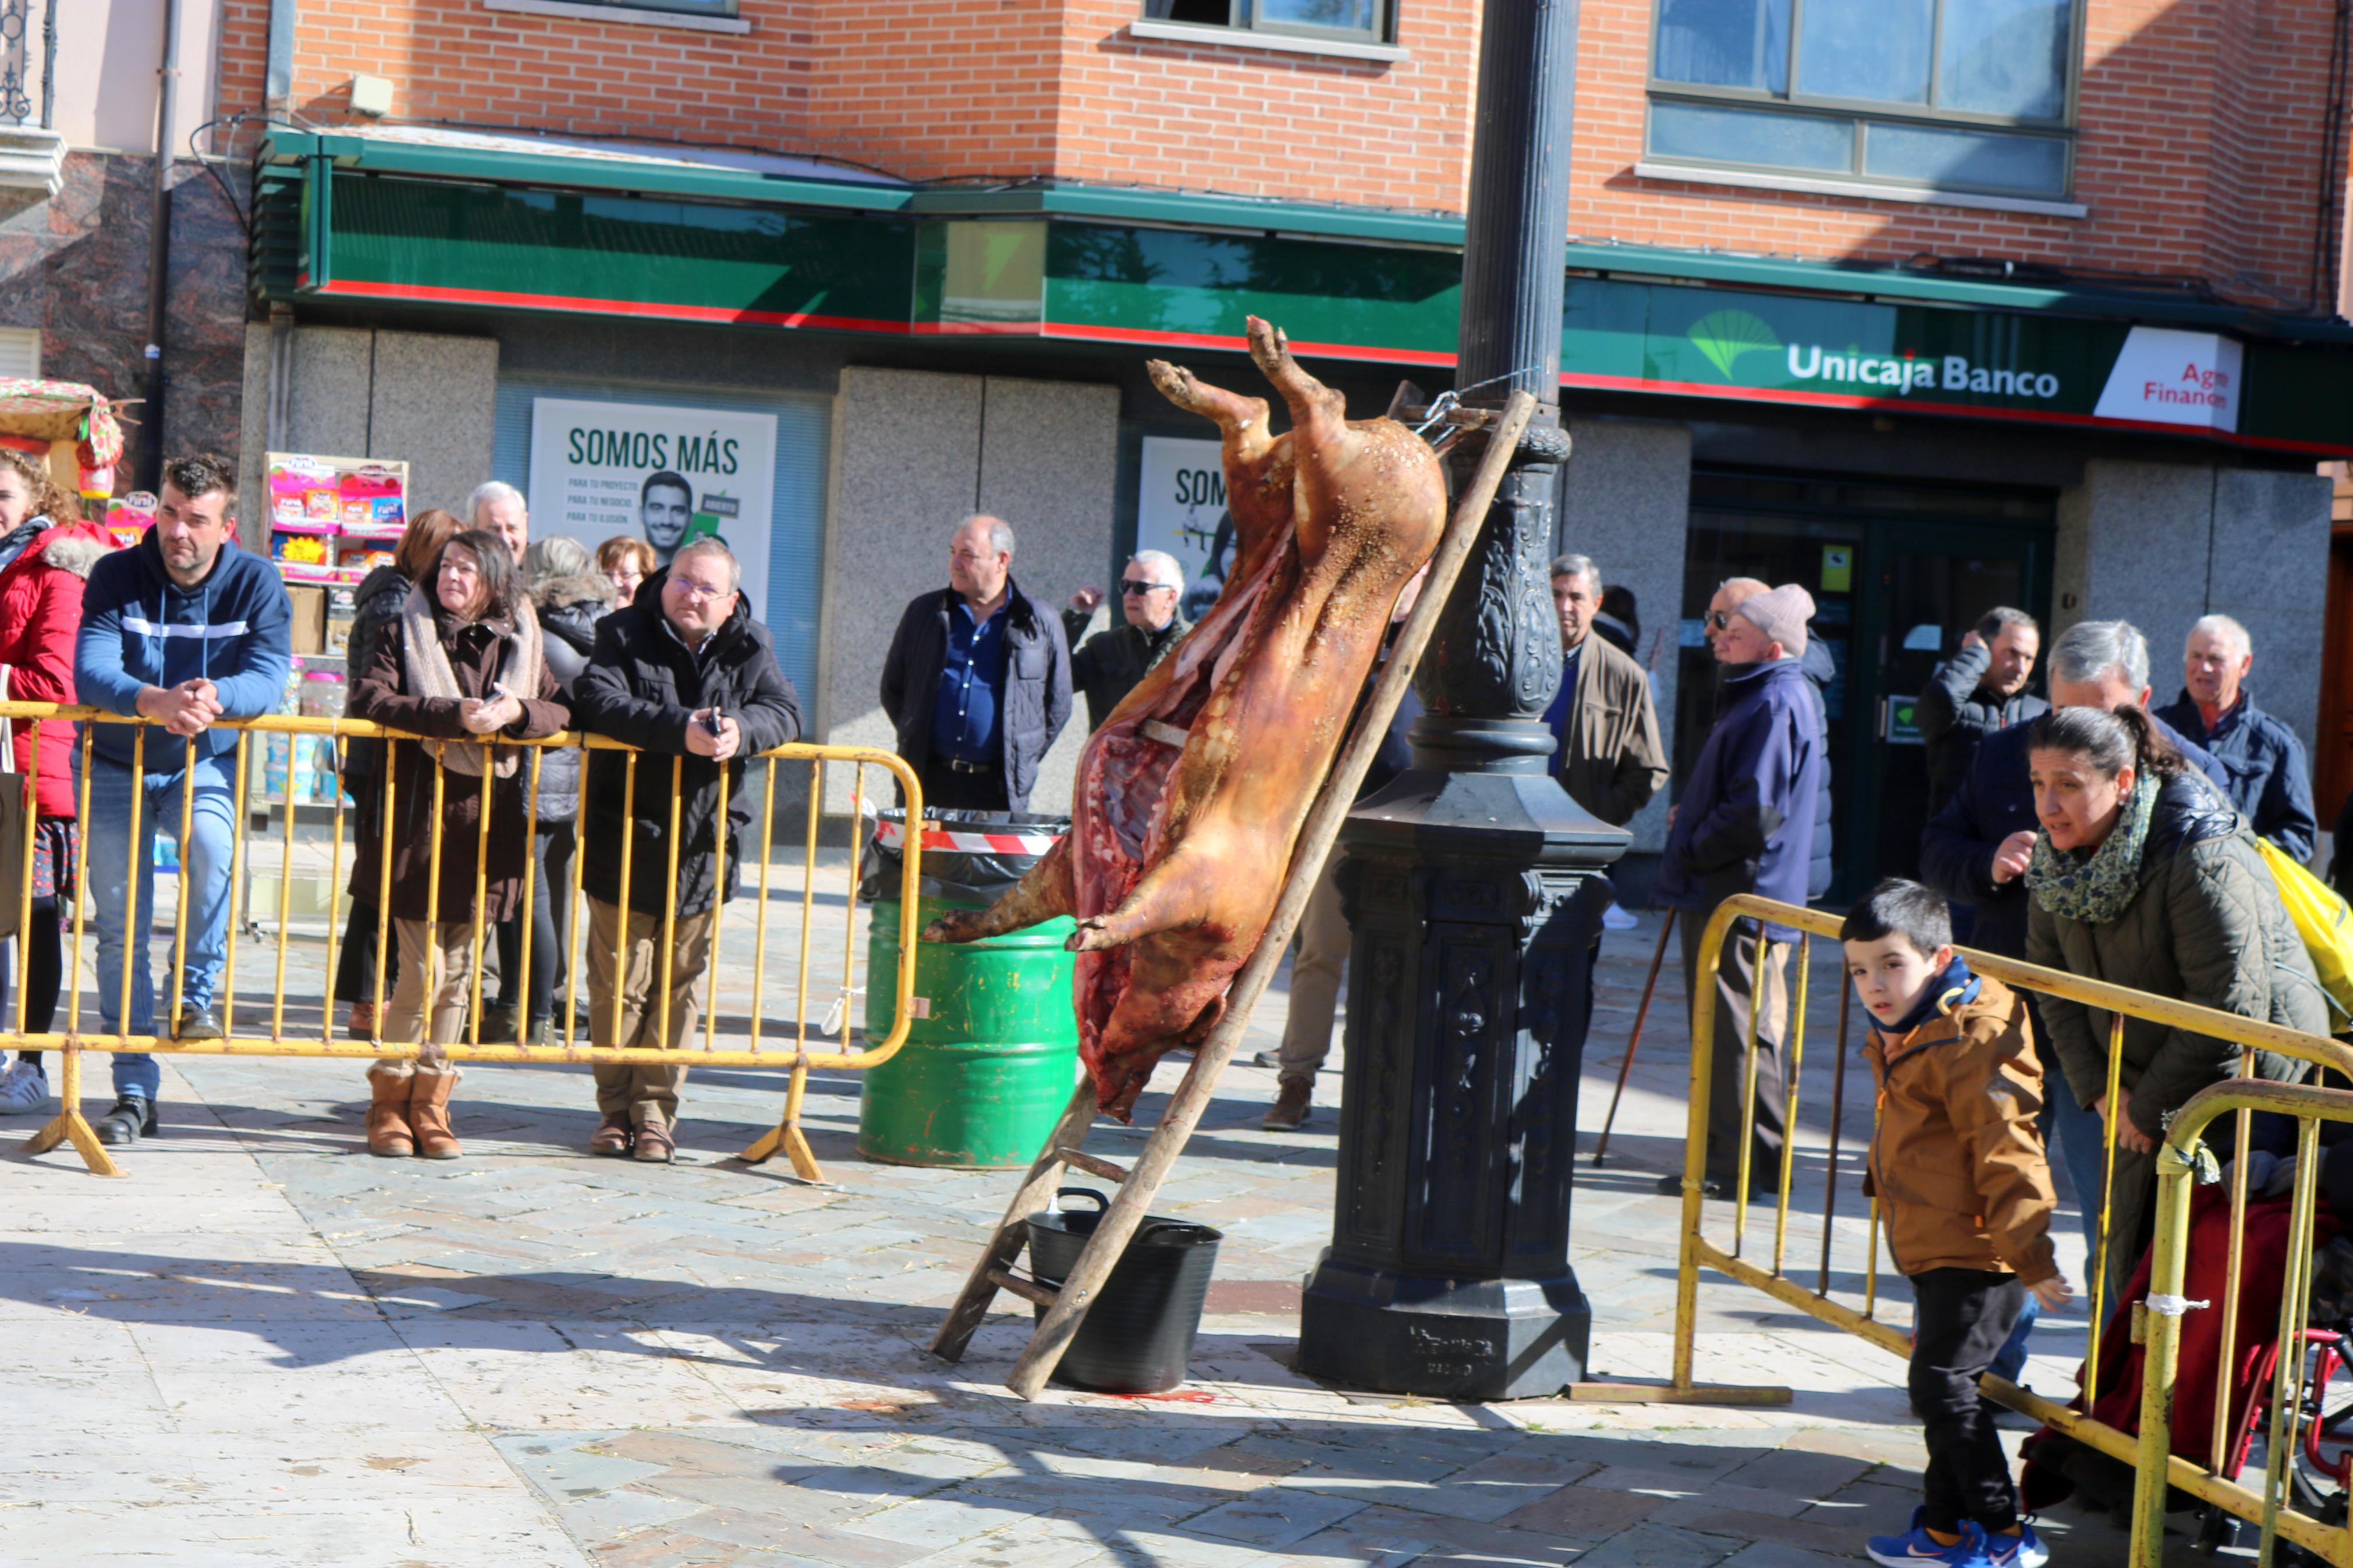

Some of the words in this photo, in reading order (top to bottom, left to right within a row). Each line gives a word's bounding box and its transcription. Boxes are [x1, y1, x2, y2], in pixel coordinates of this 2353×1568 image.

[1788, 343, 1936, 395] Unicaja
[1942, 355, 2059, 398] Banco
[568, 428, 668, 470] SOMOS
[677, 430, 739, 475] MÁS
[568, 478, 587, 488] PARA
[590, 479, 598, 489] TU
[1175, 468, 1226, 506] SOM
[567, 495, 587, 504] PARA
[590, 496, 598, 506] TU
[566, 511, 586, 521] PARA
[588, 513, 598, 522] TU
